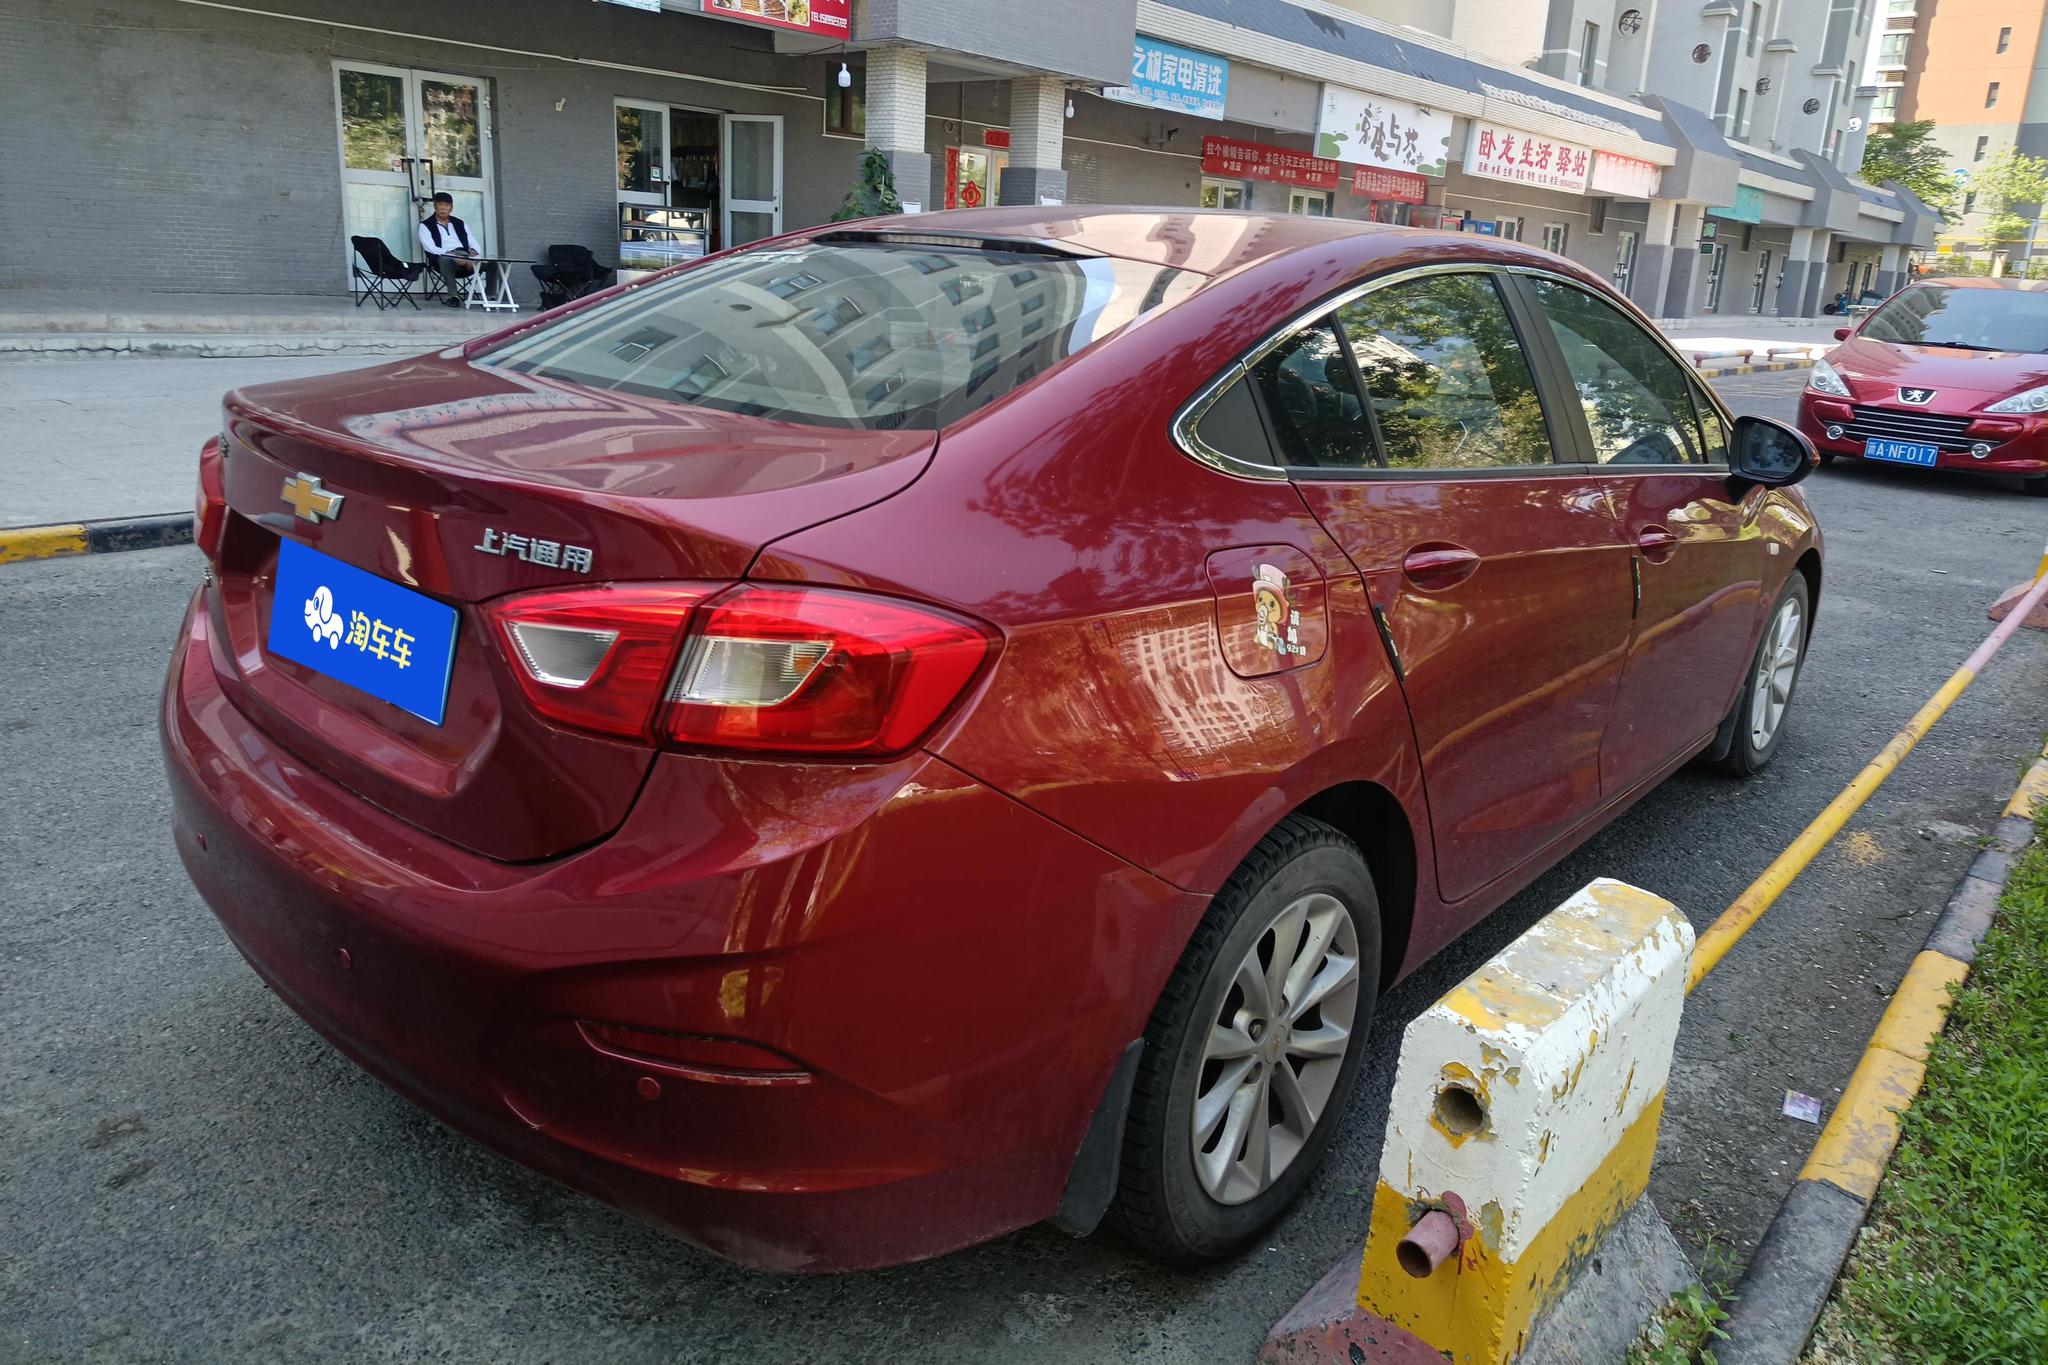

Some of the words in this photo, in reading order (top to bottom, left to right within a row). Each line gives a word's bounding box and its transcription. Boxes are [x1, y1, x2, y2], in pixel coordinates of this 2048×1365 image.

[1479, 129, 1587, 177] 卧龙生活驿站
[474, 527, 593, 574] 上汽通用
